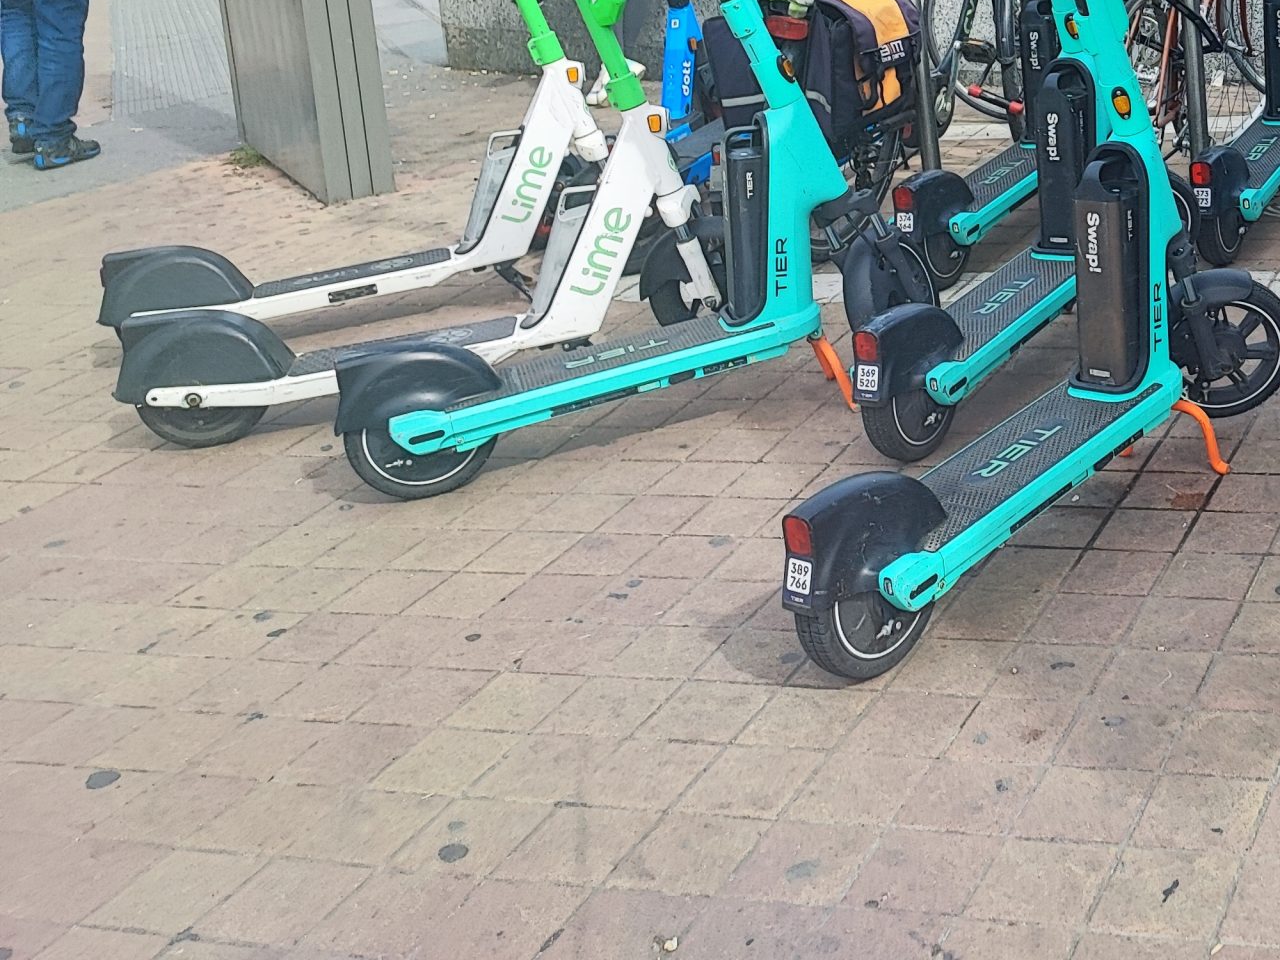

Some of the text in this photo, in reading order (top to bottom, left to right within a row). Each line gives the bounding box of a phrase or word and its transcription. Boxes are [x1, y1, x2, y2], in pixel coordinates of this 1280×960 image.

[1029, 30, 1041, 71] Swap!
[682, 60, 691, 96] dott
[1046, 112, 1061, 162] Swap!
[1247, 135, 1279, 162] TIER
[979, 159, 1029, 186] TIER
[1085, 212, 1102, 274] Swap!
[775, 237, 788, 297] TIER
[972, 277, 1037, 316] TIER
[1153, 281, 1163, 353] TIER
[564, 338, 671, 370] TIER
[859, 379, 876, 389] 520
[860, 368, 876, 378] 369
[972, 425, 1063, 478] TIER
[789, 576, 808, 591] 766
[790, 561, 809, 577] 389
